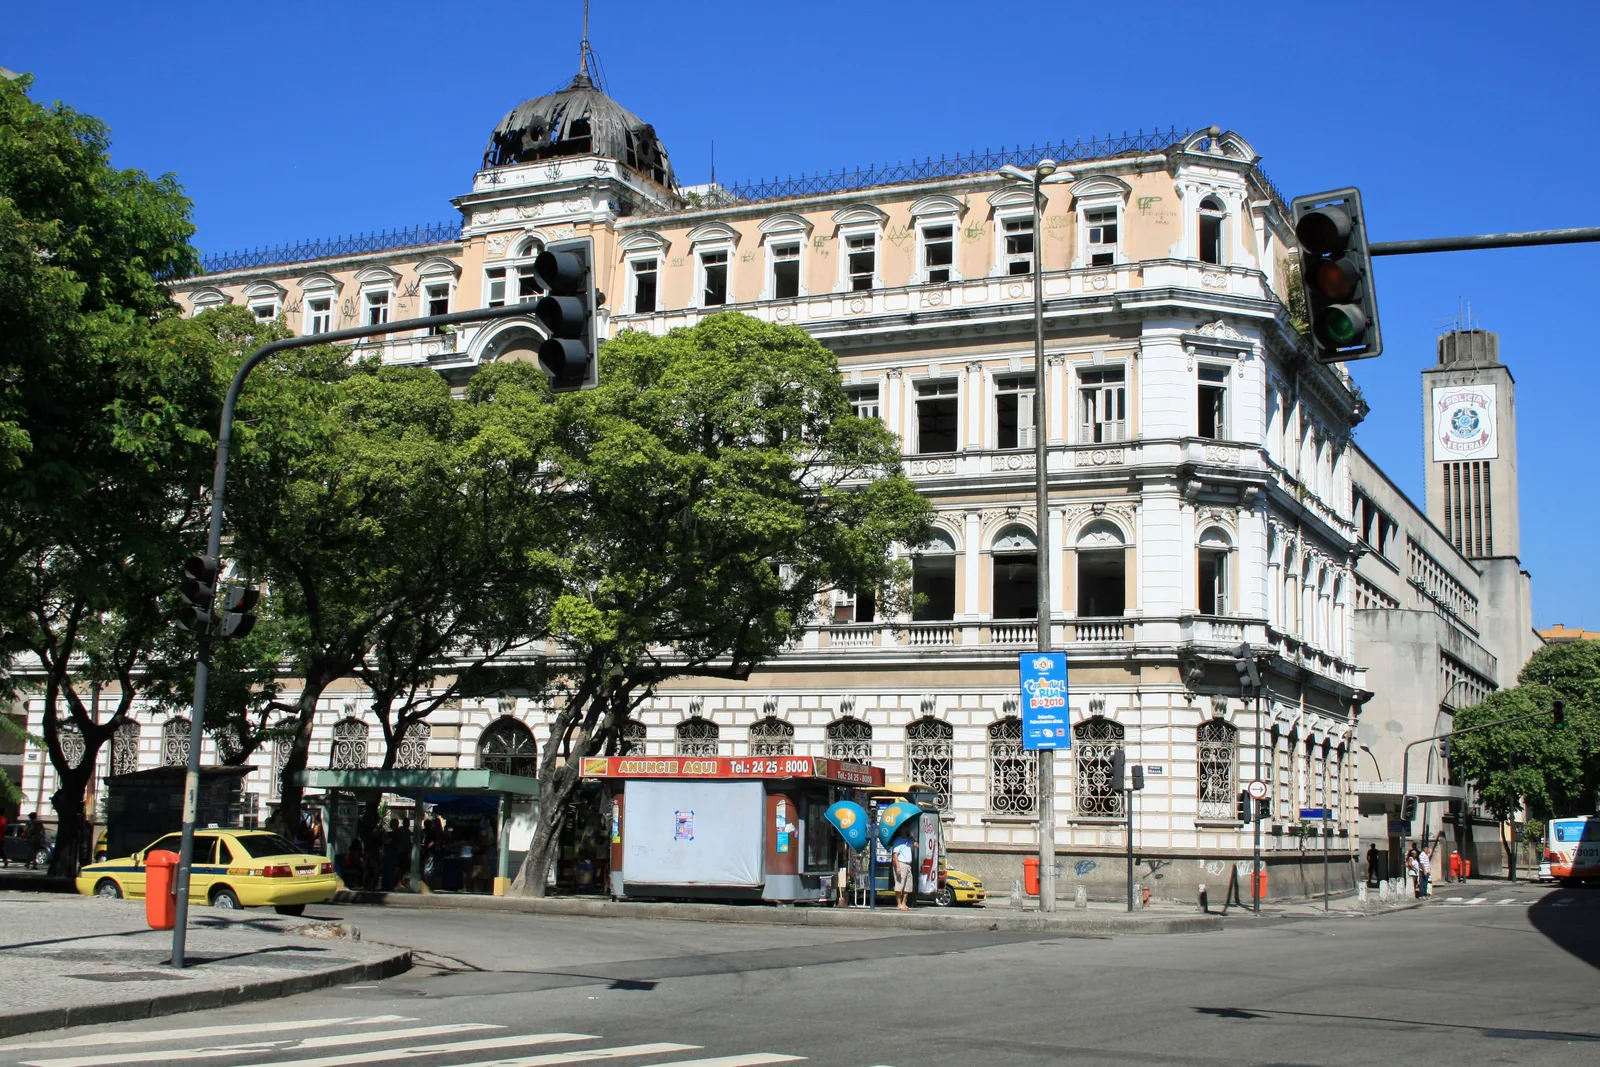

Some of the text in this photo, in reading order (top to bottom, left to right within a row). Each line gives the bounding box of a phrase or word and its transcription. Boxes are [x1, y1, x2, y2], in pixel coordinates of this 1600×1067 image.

[1447, 440, 1484, 450] FEDERAL
[1044, 698, 1064, 708] 2010
[619, 761, 678, 773] ANUNCIE
[682, 761, 717, 774] AQUI
[730, 761, 750, 773] Tel.:
[752, 761, 763, 773] 24
[766, 761, 777, 773] 25
[785, 760, 808, 773] 8000
[842, 811, 851, 824] oi
[885, 814, 894, 823] oi
[1571, 848, 1598, 857] 73021
